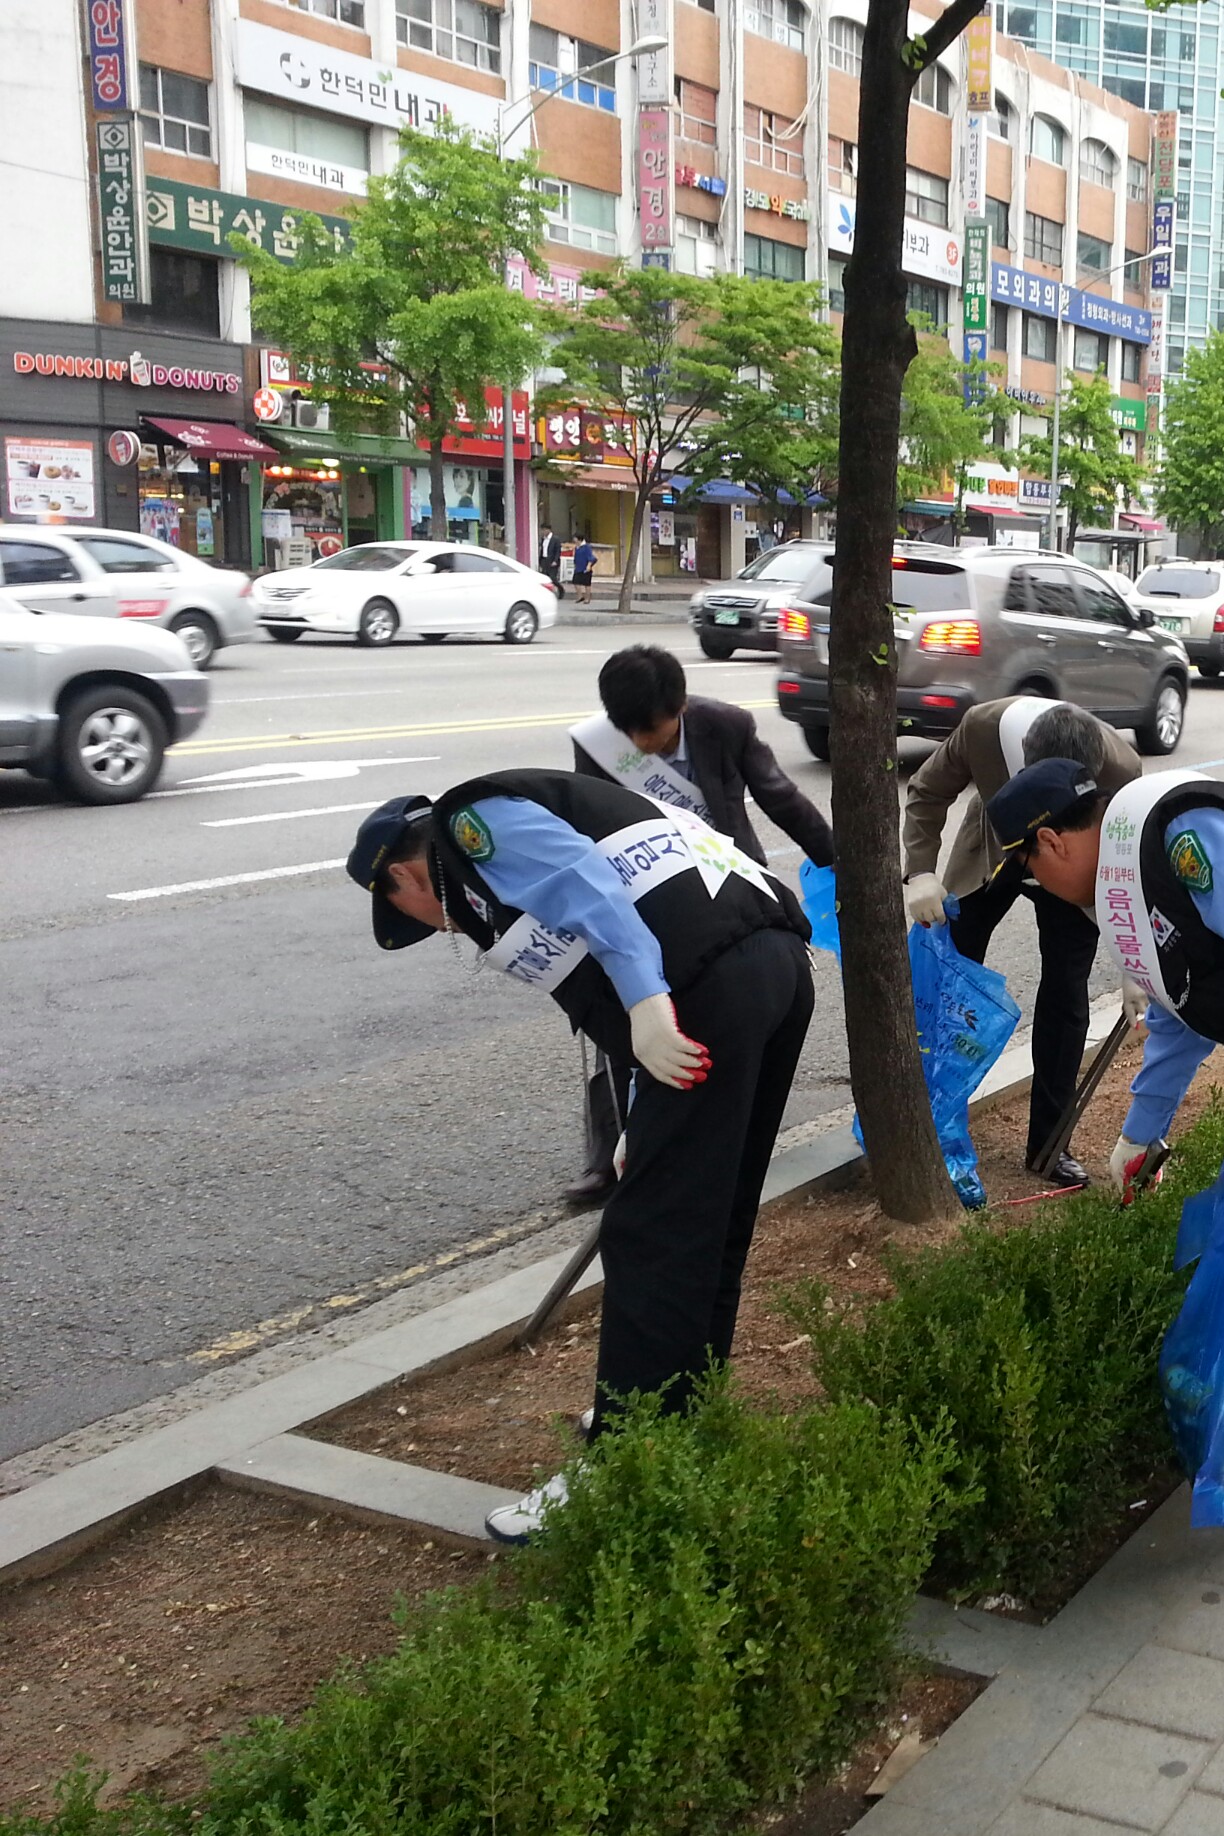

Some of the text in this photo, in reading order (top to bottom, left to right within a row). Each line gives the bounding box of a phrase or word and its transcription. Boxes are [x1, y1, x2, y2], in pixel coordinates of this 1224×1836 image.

[271, 153, 345, 190] 한덕민내과
[642, 148, 666, 218] 안경
[1157, 143, 1174, 188] 전당포
[103, 152, 134, 283] 박상윤안과
[947, 245, 958, 263] 3F
[108, 283, 136, 299] 의원
[965, 282, 986, 296] 의원
[14, 352, 240, 394] DUNKIN' DONUTS
